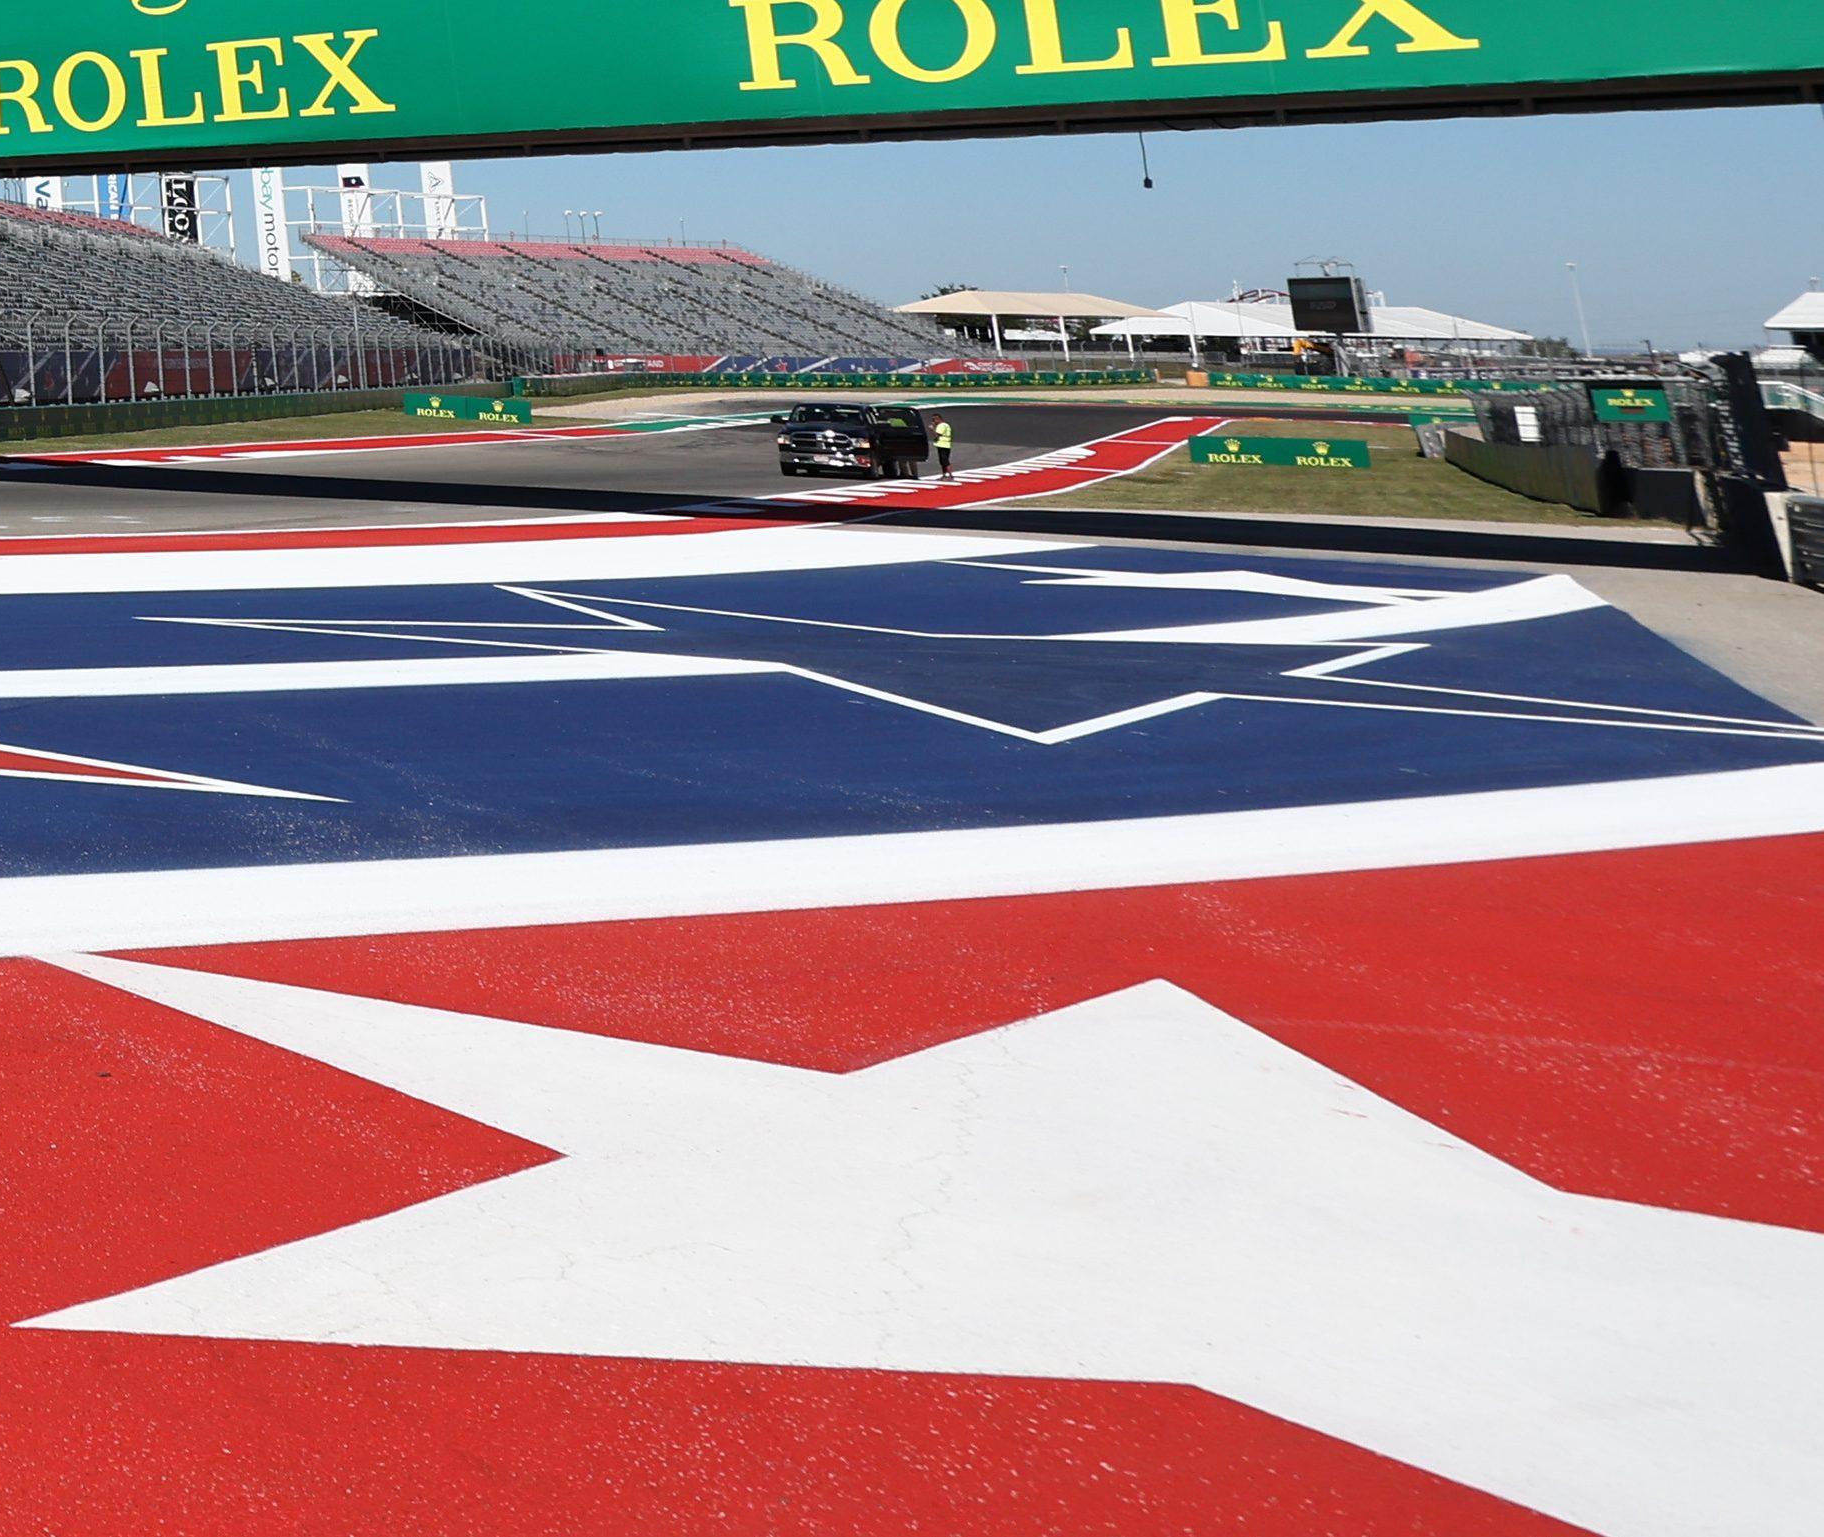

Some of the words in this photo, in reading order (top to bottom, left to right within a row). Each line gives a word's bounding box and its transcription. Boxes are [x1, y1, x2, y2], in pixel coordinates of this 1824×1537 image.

[107, 173, 119, 210] RICAN
[260, 166, 274, 210] bay
[264, 212, 280, 275] motor
[416, 408, 455, 419] ROLEX
[479, 412, 519, 423] ROLEX
[1207, 453, 1264, 464] ROLEX
[1295, 456, 1353, 468] ROLEX
